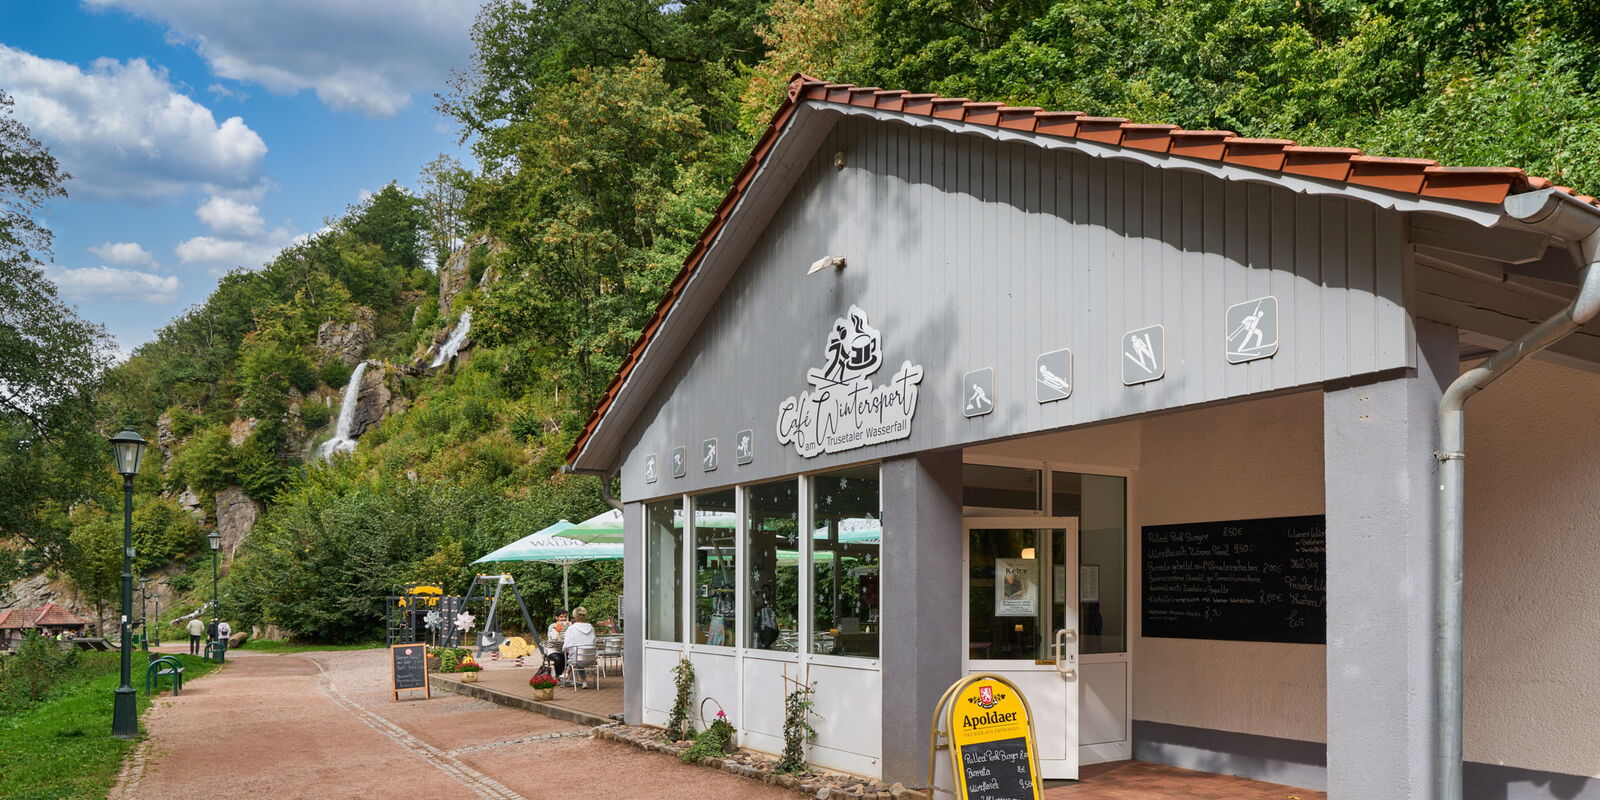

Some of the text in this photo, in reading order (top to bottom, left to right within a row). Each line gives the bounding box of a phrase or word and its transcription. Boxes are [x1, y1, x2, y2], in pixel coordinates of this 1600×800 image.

[780, 368, 918, 448] Café Wintersport
[805, 420, 907, 452] am Trusetaler Wasserfall
[962, 711, 1017, 729] Apoldaer
[964, 752, 988, 764] Pulled
